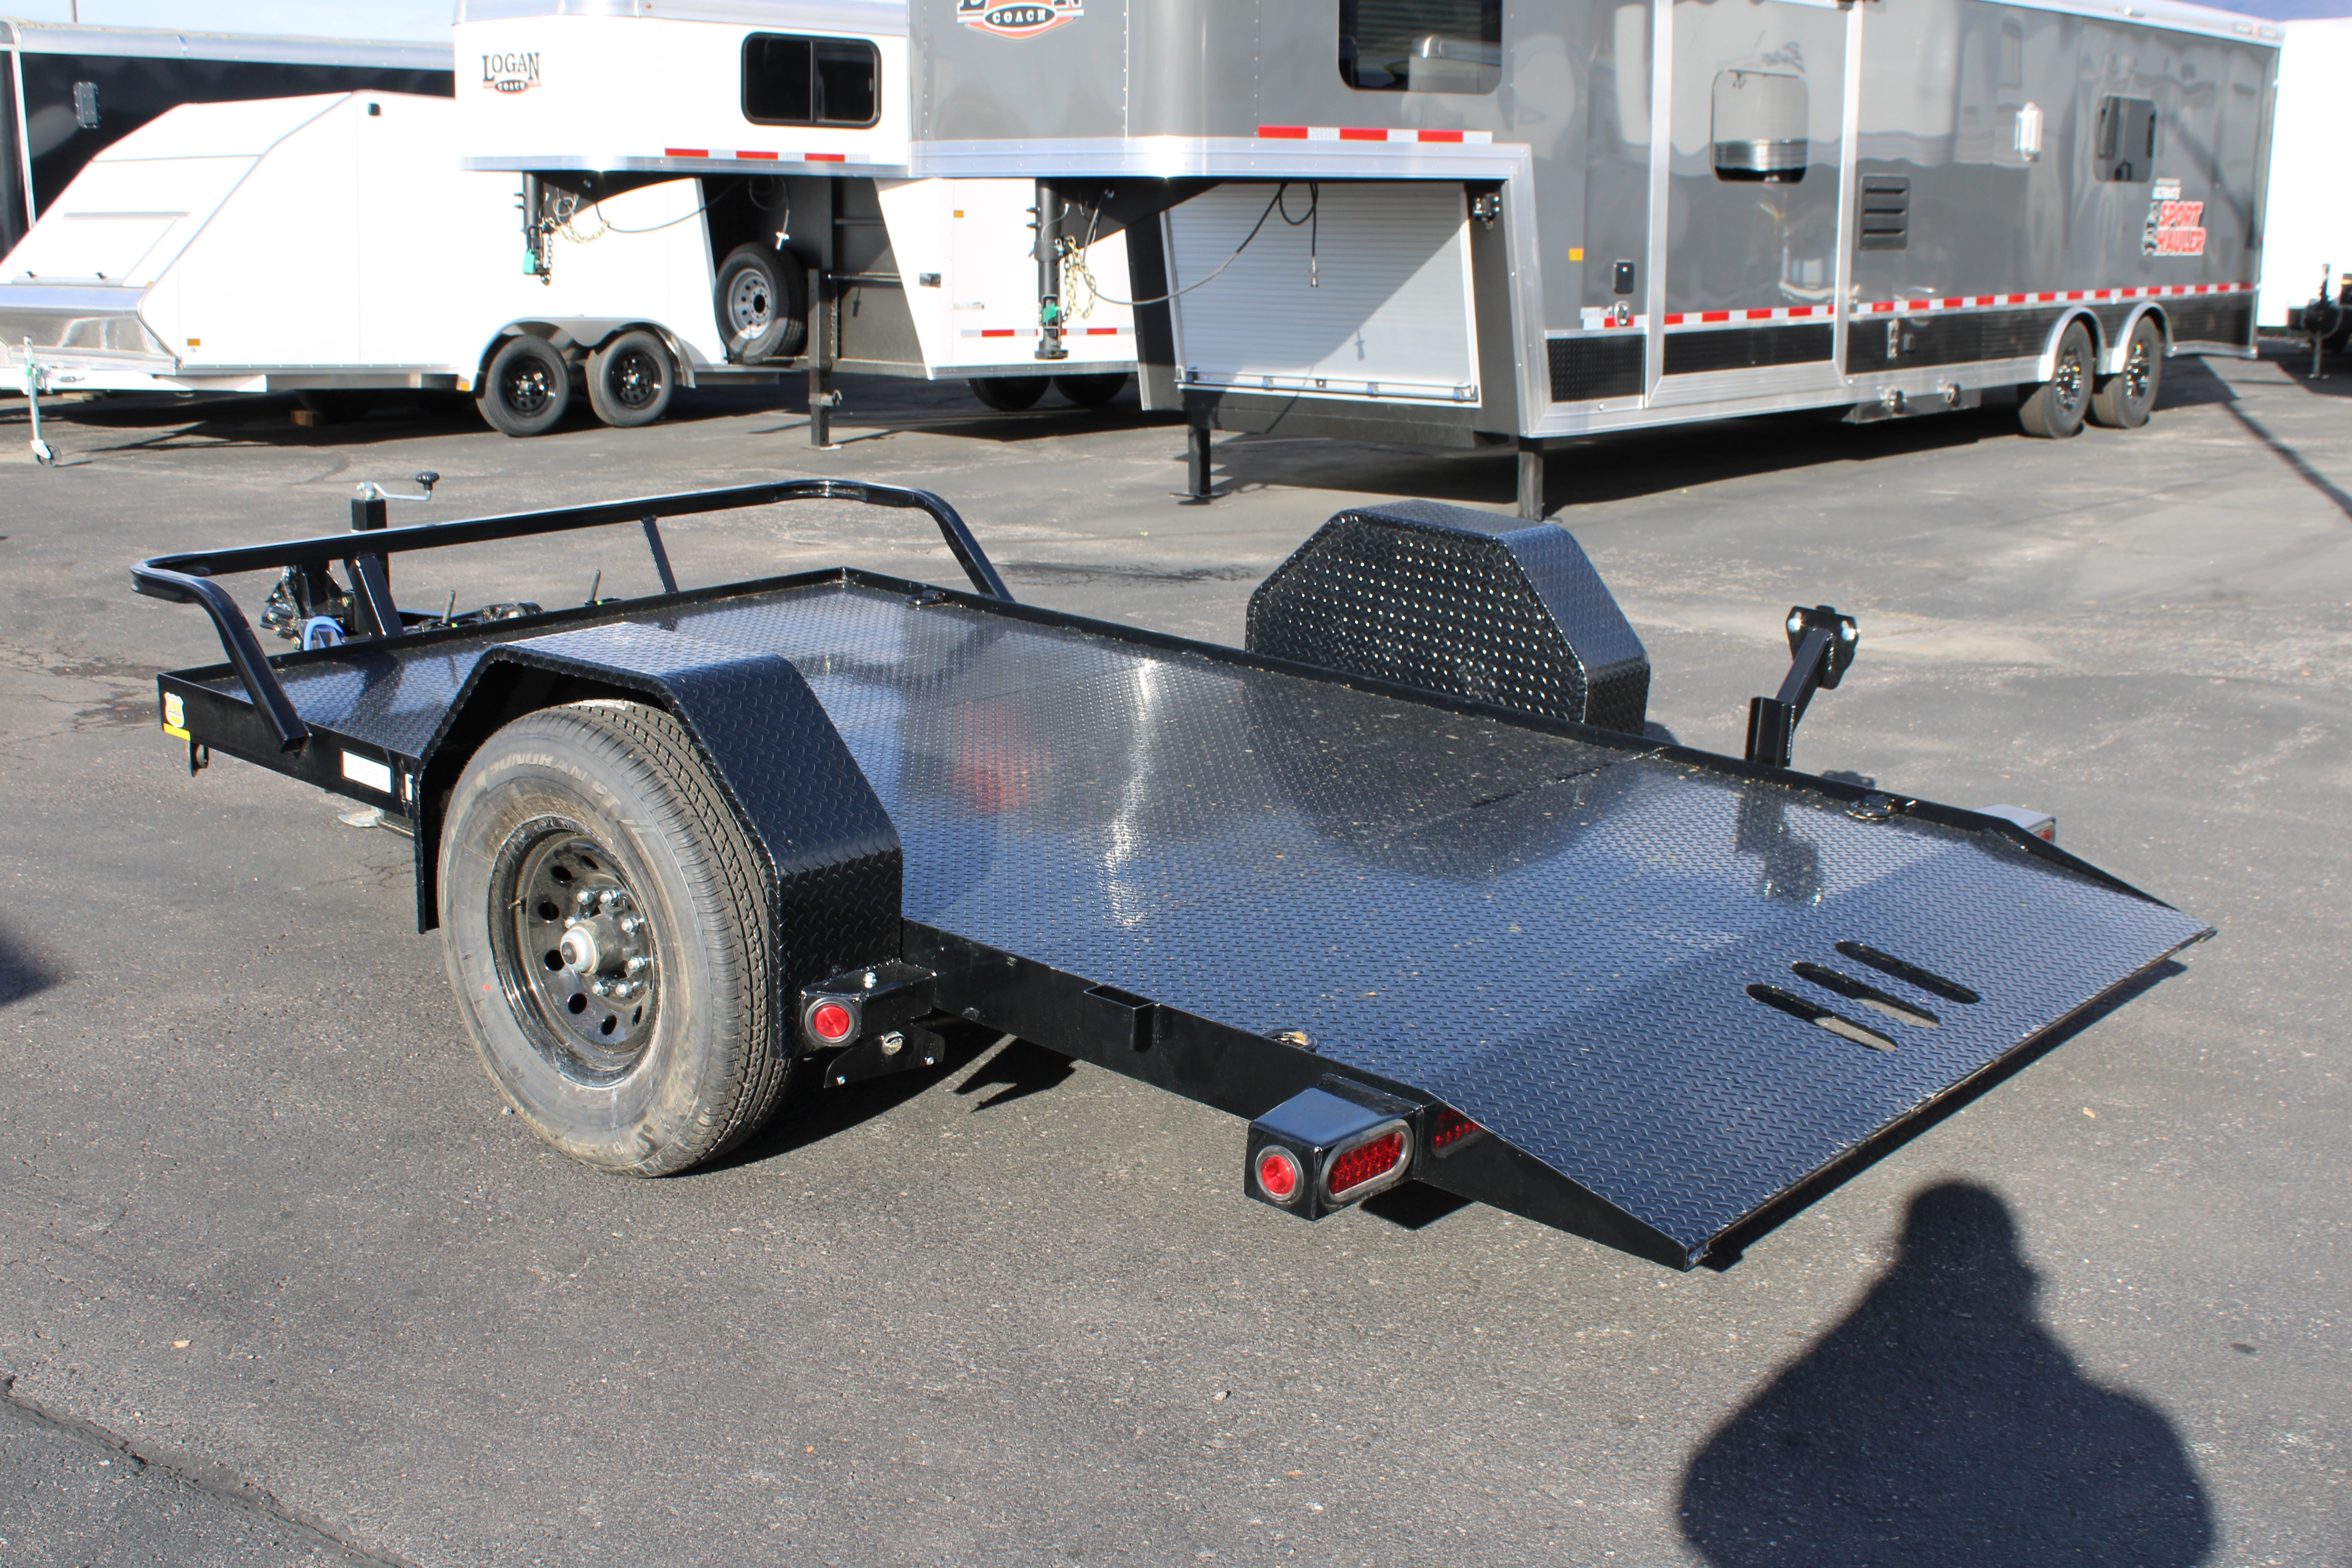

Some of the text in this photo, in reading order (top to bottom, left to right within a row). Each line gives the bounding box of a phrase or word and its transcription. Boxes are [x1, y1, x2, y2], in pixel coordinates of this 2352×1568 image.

[992, 9, 1046, 24] COACH
[482, 52, 541, 84] LOGAN
[497, 81, 526, 91] COACH
[2159, 200, 2204, 227] SPORT
[2153, 227, 2206, 256] HAULER
[591, 780, 621, 808] ST
